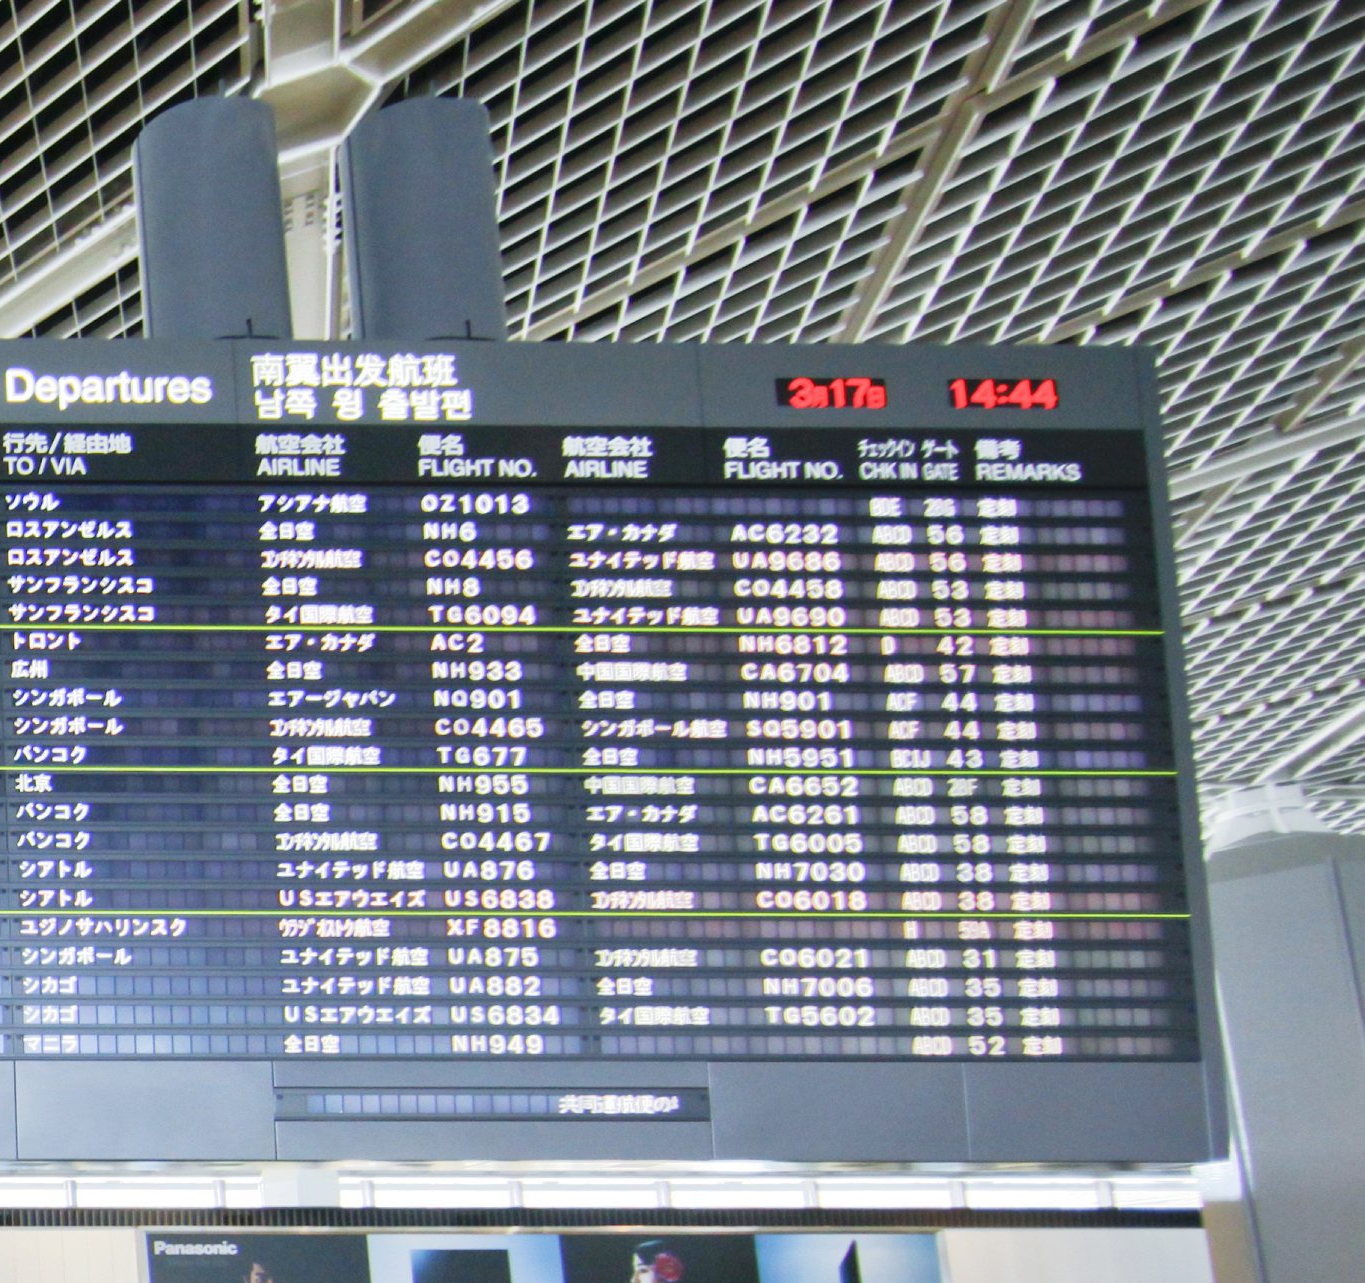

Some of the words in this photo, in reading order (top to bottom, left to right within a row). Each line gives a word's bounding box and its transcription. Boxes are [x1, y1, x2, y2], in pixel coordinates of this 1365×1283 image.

[250, 352, 459, 387] 南翼出发航班
[5, 368, 214, 410] Departures
[949, 378, 1059, 409] 14:44
[254, 388, 317, 420] 남쪽
[332, 388, 364, 421] 윙
[378, 387, 473, 421] 출발편
[255, 433, 346, 455] 航空会社
[4, 456, 35, 475] TO
[50, 456, 87, 475] VIA
[257, 458, 341, 477] AIRLINE
[418, 458, 495, 477] FLIGHT
[498, 459, 538, 478] NO.
[565, 460, 648, 479] AIRLINE
[725, 461, 801, 480] FLIGHT
[804, 461, 844, 480] NO.
[859, 462, 896, 480] CHK
[900, 462, 918, 480] IN
[923, 463, 959, 481] GATE
[975, 463, 1081, 482] REMARKS
[5, 493, 60, 512] ソウル
[420, 494, 530, 514] OZ1013
[259, 522, 315, 541] 全日空
[423, 522, 477, 542] NH6
[731, 524, 839, 544] AC6232
[926, 525, 965, 545] 56
[12, 633, 82, 652] トロント
[431, 634, 485, 654] AC2
[738, 635, 848, 656] NH6812
[936, 636, 974, 656] 42
[434, 689, 521, 709] NQ901
[743, 692, 832, 711] NH901
[941, 692, 978, 711] 44
[15, 774, 52, 793] 北京
[438, 775, 529, 795] NH955
[748, 777, 859, 797] CA6652
[19, 859, 93, 878] シアトル
[443, 861, 535, 880] UA876
[450, 976, 541, 996] UA882
[154, 1240, 238, 1255] Panasonic
